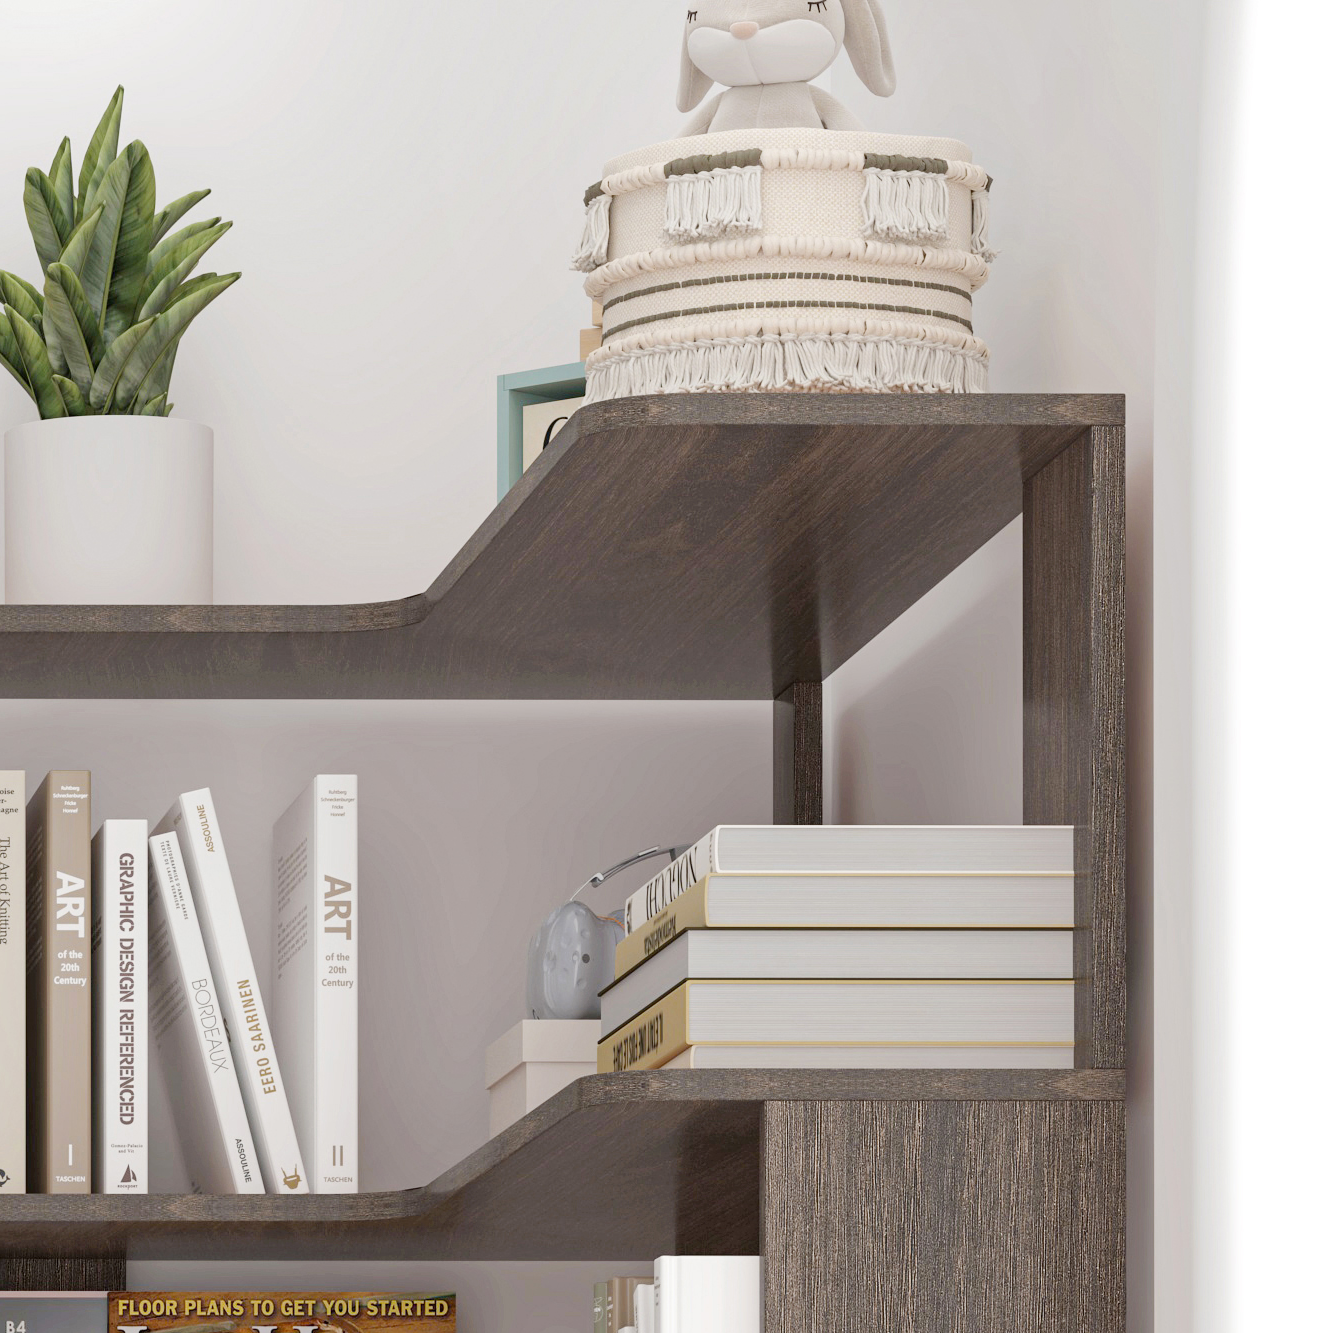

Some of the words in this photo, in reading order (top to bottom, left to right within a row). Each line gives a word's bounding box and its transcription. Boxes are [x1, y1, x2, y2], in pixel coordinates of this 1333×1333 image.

[55, 870, 84, 937] ART
[118, 851, 133, 931] GRAPHIC
[118, 937, 133, 1002] DESIGN
[190, 977, 228, 1072] BORDEAUX
[238, 979, 266, 1051] SAARINEN
[118, 1008, 133, 1124] REFERENCED
[255, 1056, 276, 1095] EERO
[4, 1319, 26, 1333] B4
